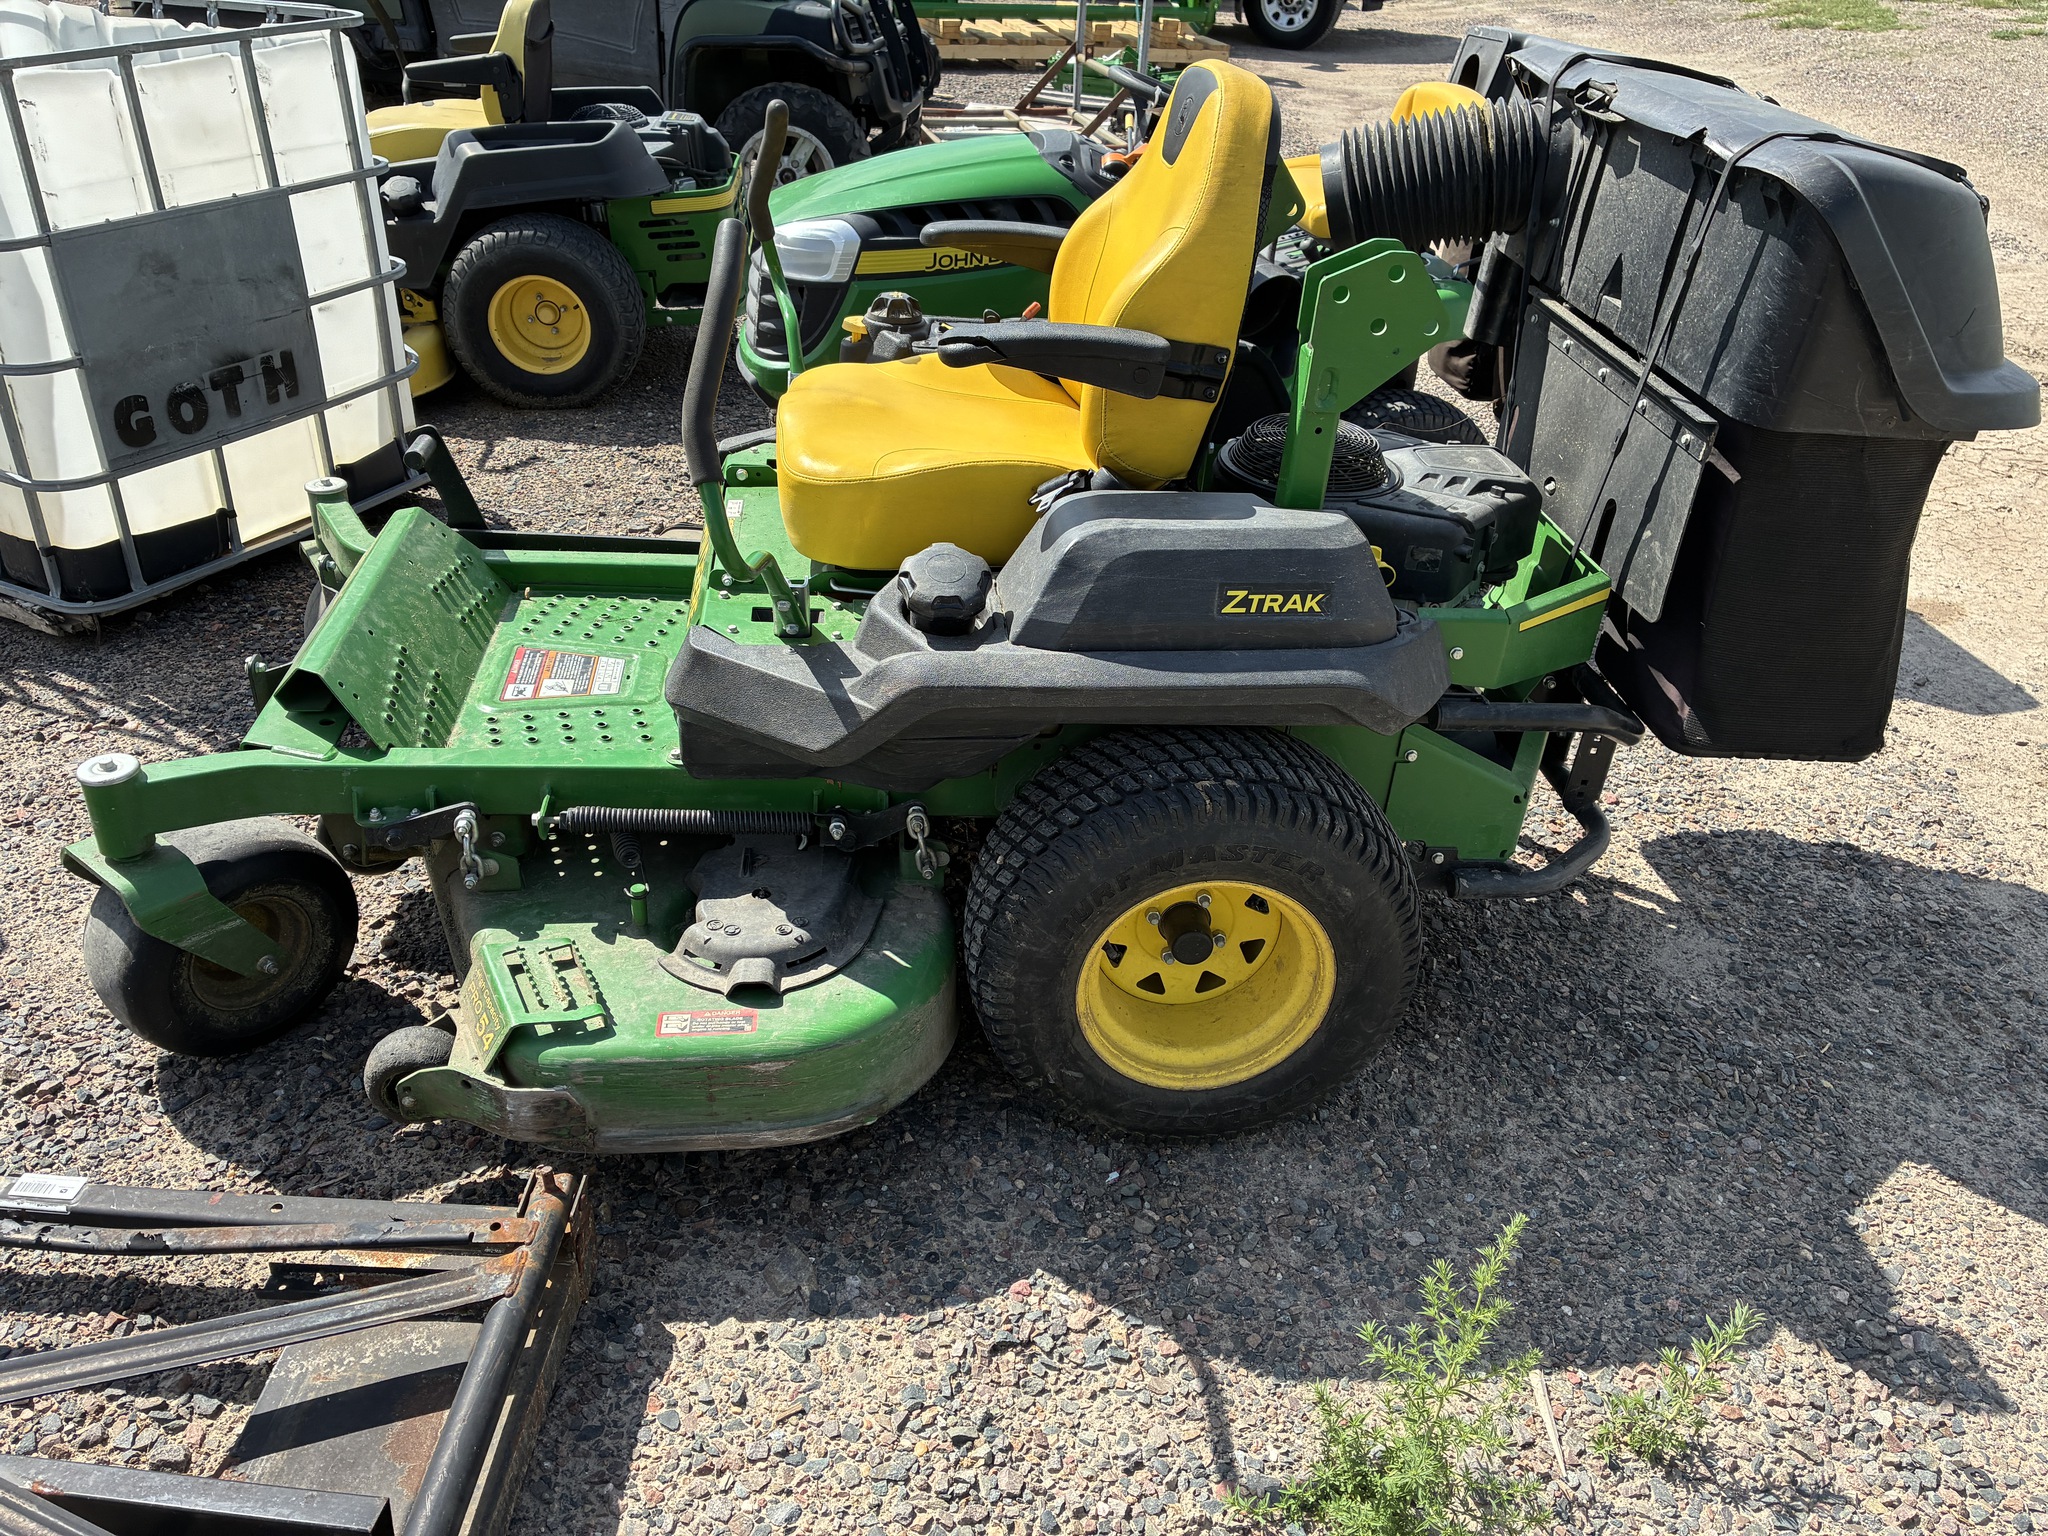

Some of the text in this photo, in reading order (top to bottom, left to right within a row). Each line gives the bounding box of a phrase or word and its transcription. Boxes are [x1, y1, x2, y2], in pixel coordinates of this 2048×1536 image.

[925, 252, 984, 269] JOHN
[114, 350, 300, 448] GOTH
[1221, 590, 1325, 613] ZTRAK
[1149, 843, 1326, 882] MASTER
[468, 981, 495, 1052] PRO 54
[484, 989, 501, 1031] Capacity
